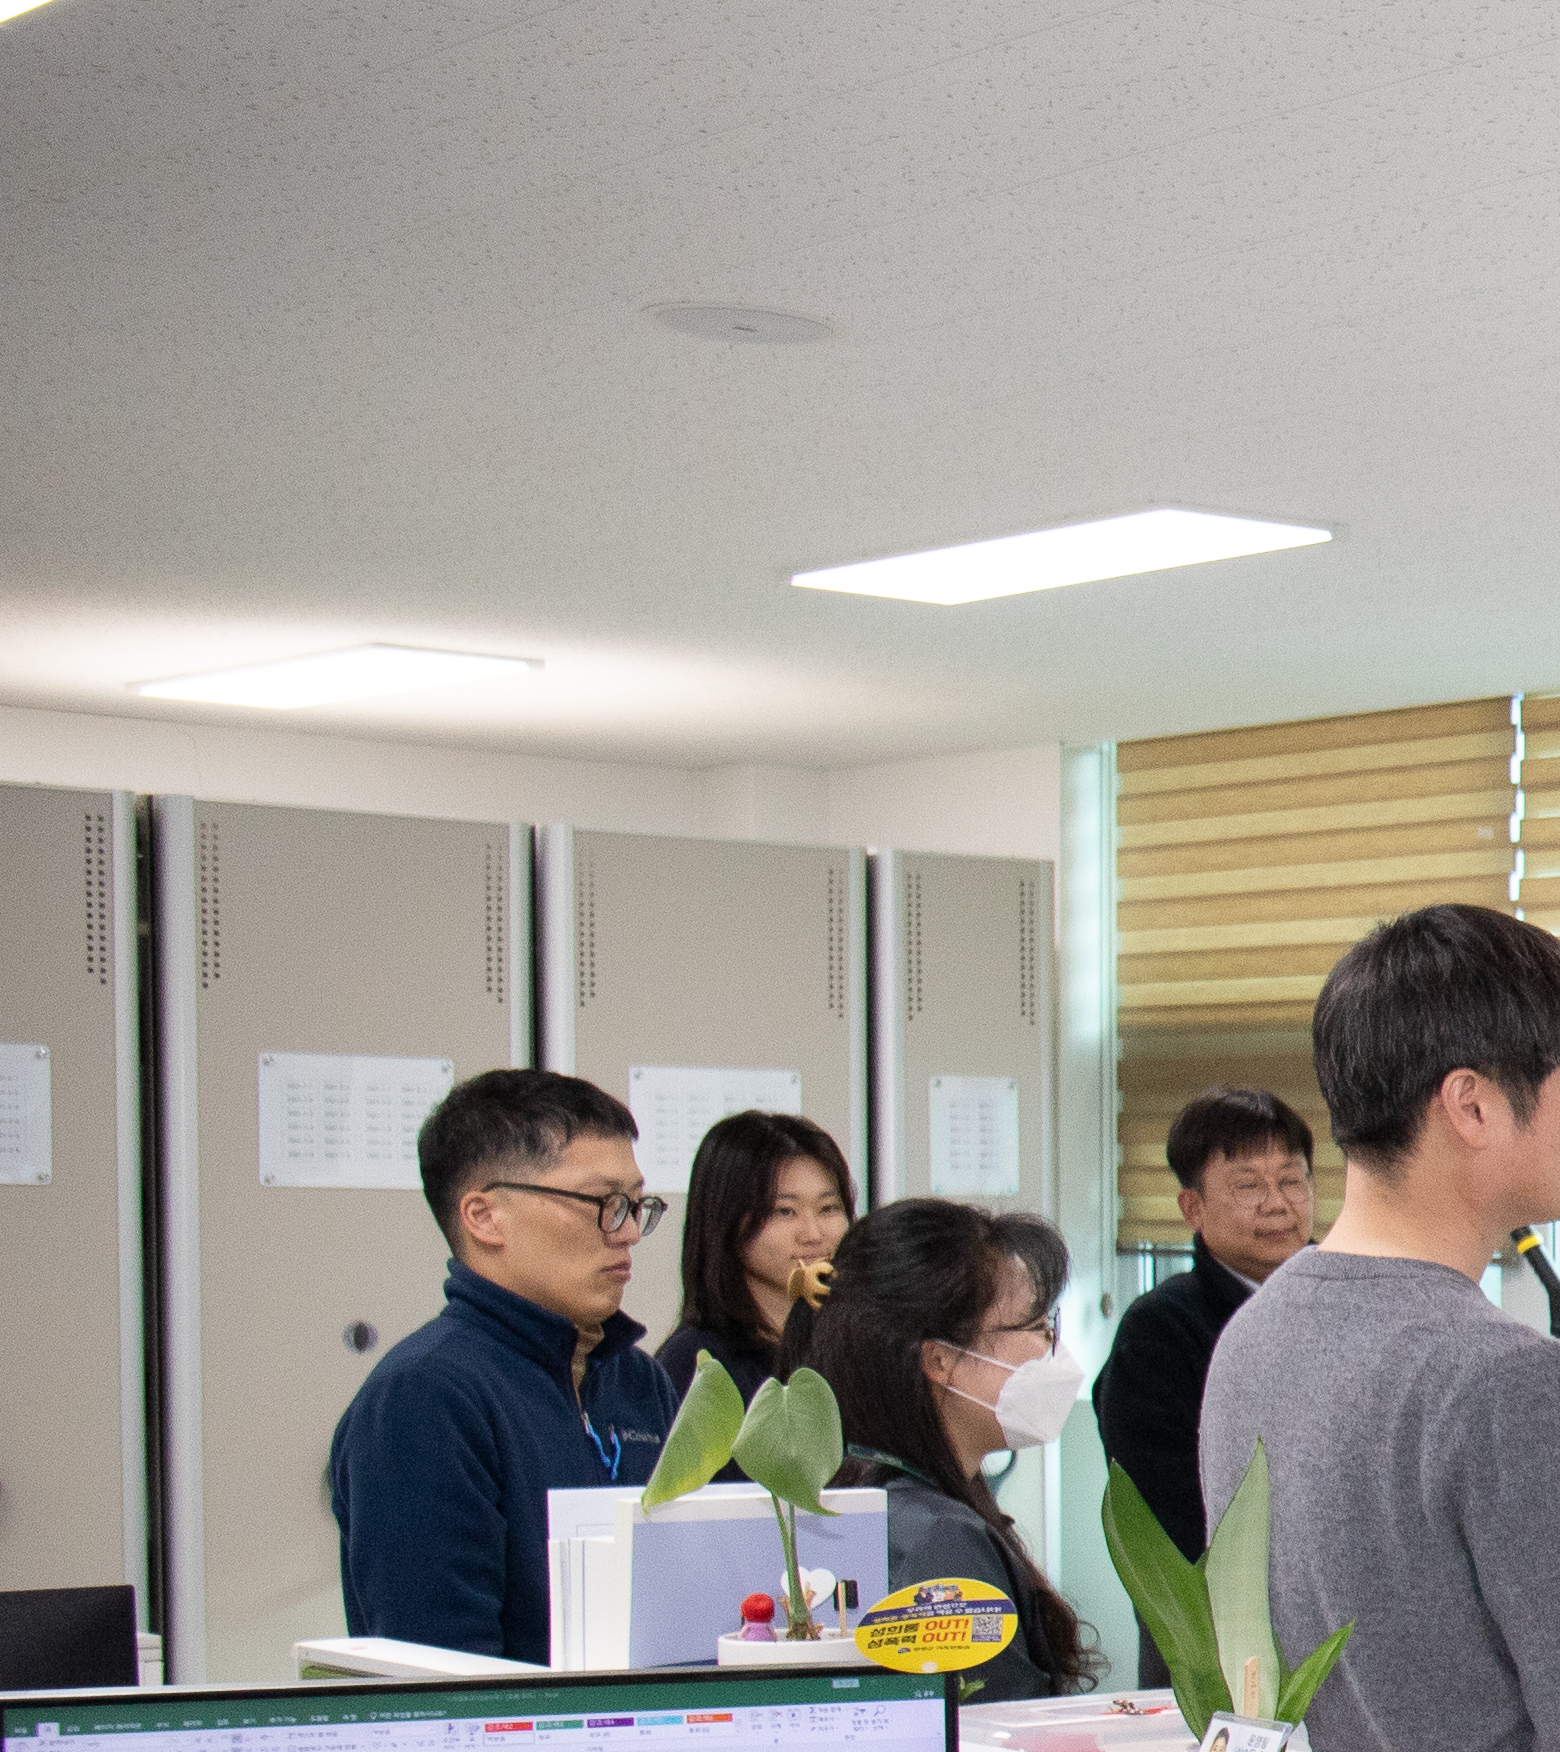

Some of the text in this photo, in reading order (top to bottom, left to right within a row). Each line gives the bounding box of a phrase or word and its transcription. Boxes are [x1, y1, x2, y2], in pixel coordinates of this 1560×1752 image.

[870, 1618, 970, 1638] 성희롱 OUT!
[867, 1634, 917, 1650] 성폭력
[922, 1631, 967, 1643] OUT!
